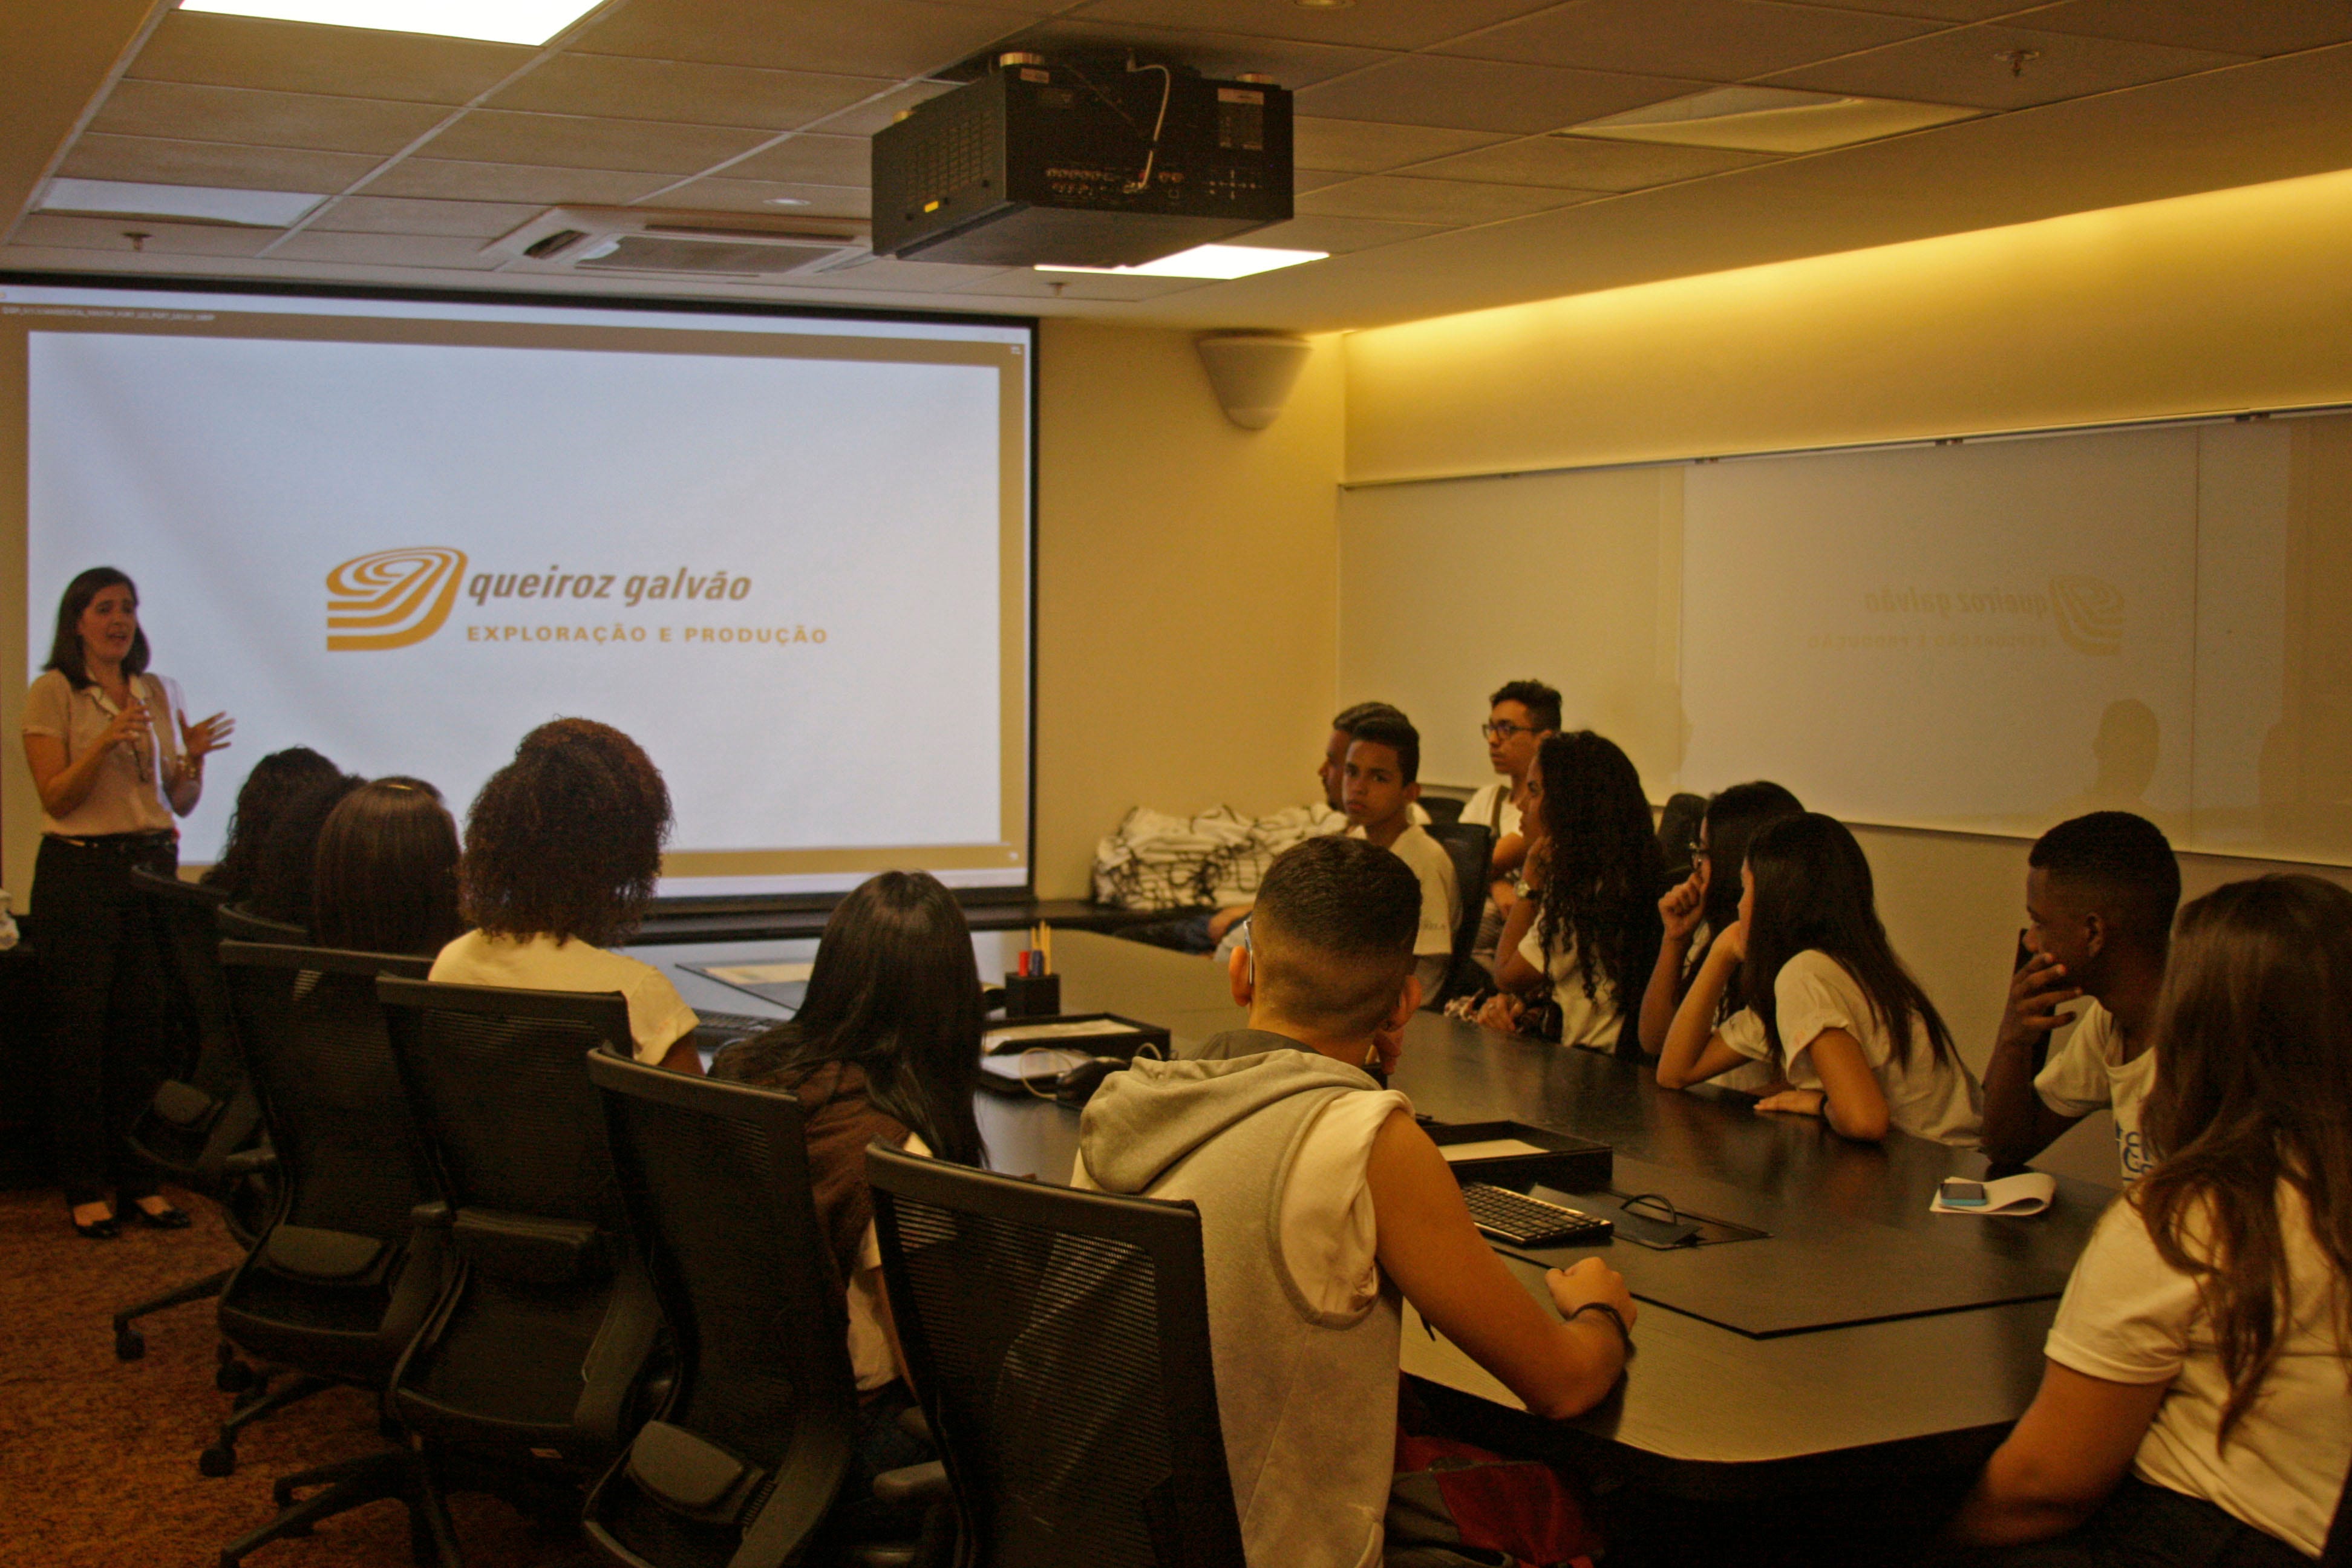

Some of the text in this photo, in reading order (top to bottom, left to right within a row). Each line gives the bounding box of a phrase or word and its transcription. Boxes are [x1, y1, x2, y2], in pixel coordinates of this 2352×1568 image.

[468, 564, 753, 608] queiroz galvão
[466, 622, 828, 647] EXPLORAÇÃO E PRODUÇÃO
